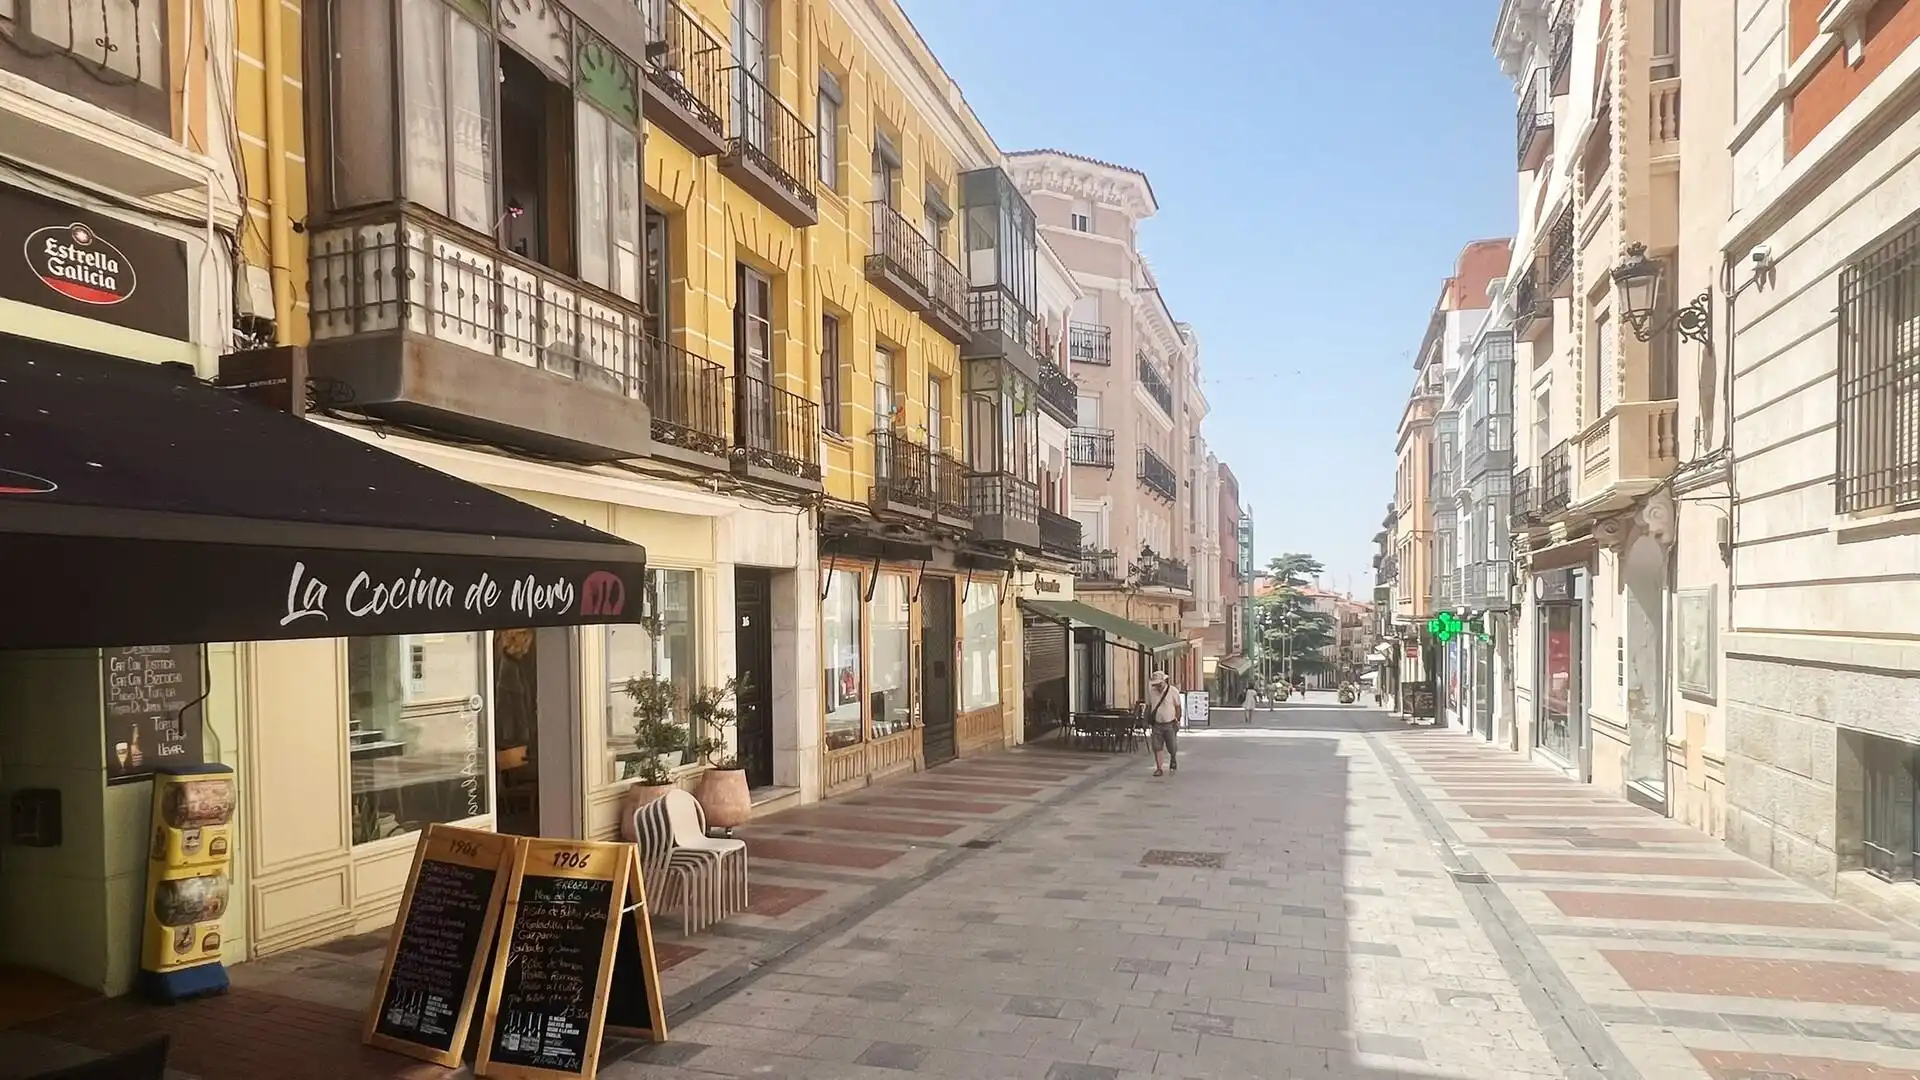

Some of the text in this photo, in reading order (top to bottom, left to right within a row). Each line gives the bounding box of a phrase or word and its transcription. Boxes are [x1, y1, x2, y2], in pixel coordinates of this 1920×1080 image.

[44, 237, 119, 274] Estrella
[48, 256, 117, 290] Galicia
[280, 561, 575, 626] La Cocina de Mery
[449, 839, 483, 858] 1906
[552, 850, 591, 868] 1906
